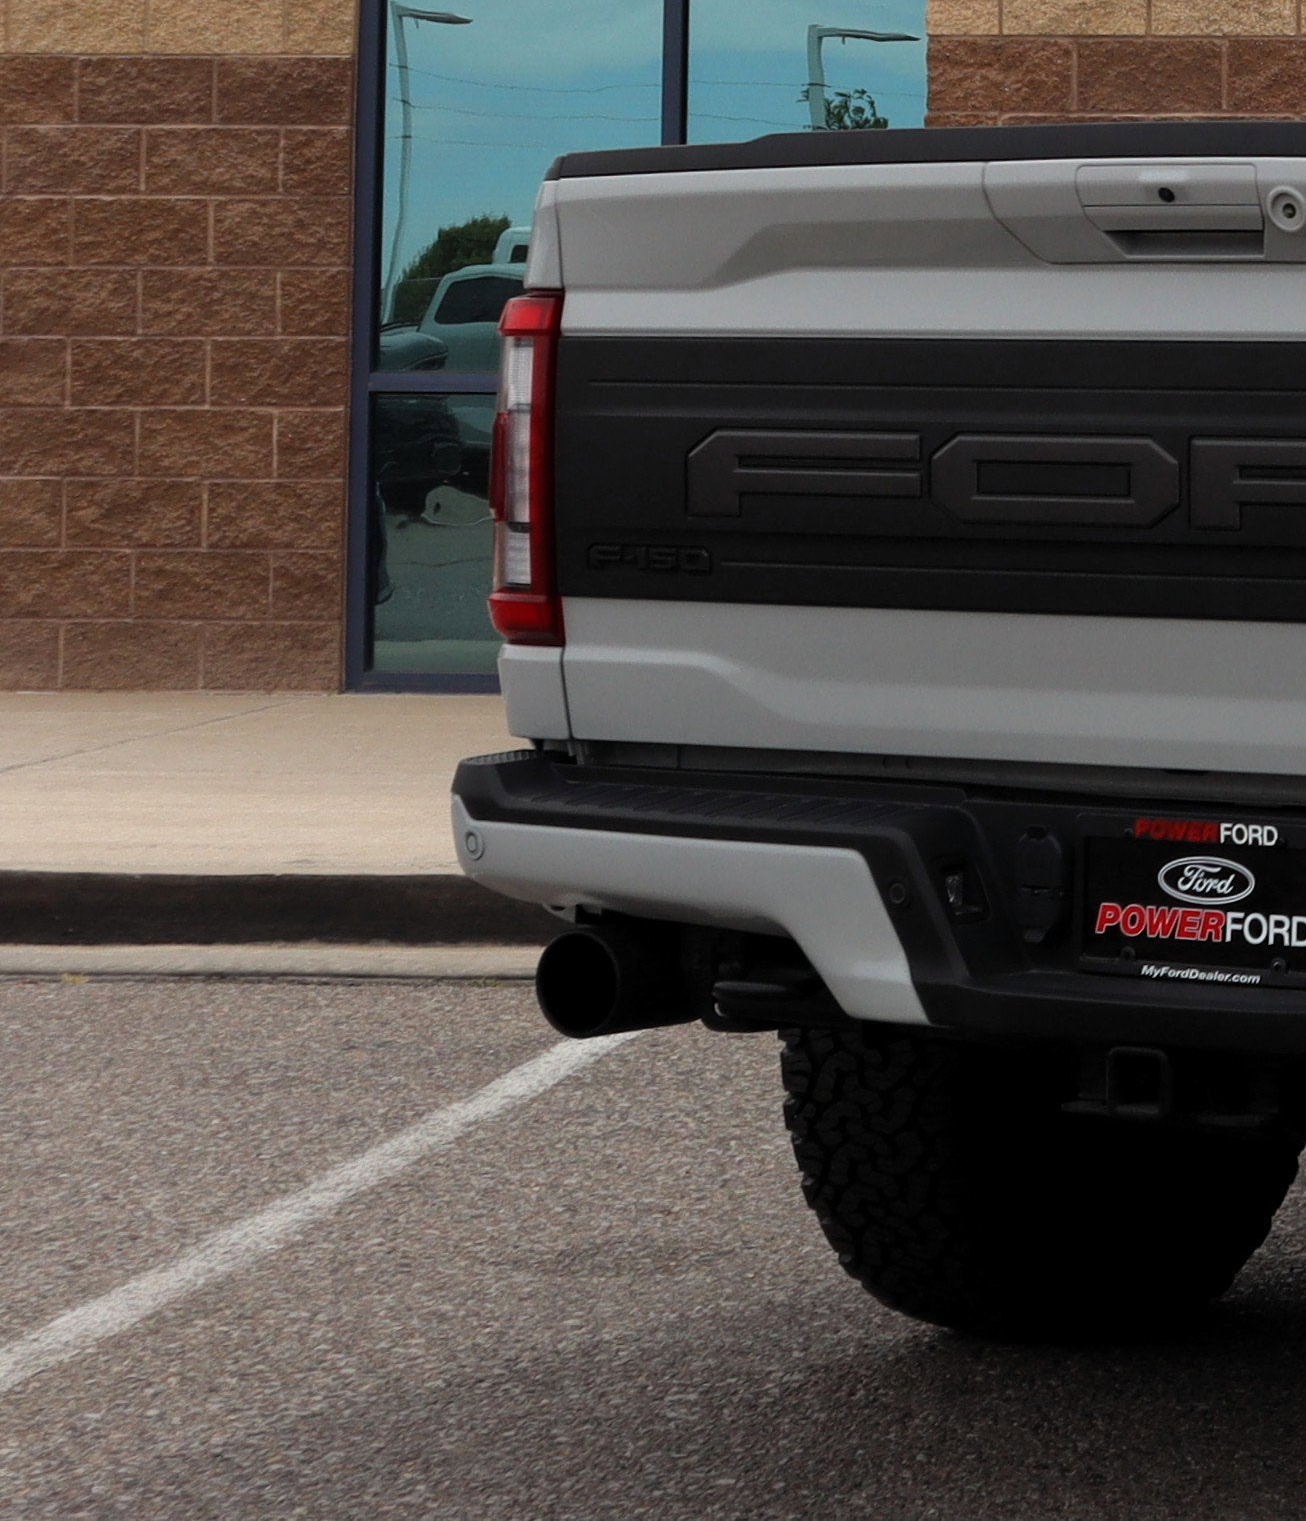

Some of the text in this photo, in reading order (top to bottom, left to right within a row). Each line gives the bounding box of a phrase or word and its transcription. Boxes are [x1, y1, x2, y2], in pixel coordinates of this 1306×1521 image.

[586, 542, 712, 575] F-150
[1177, 865, 1235, 895] Ford
[1140, 964, 1261, 985] MyFordDealer.com
